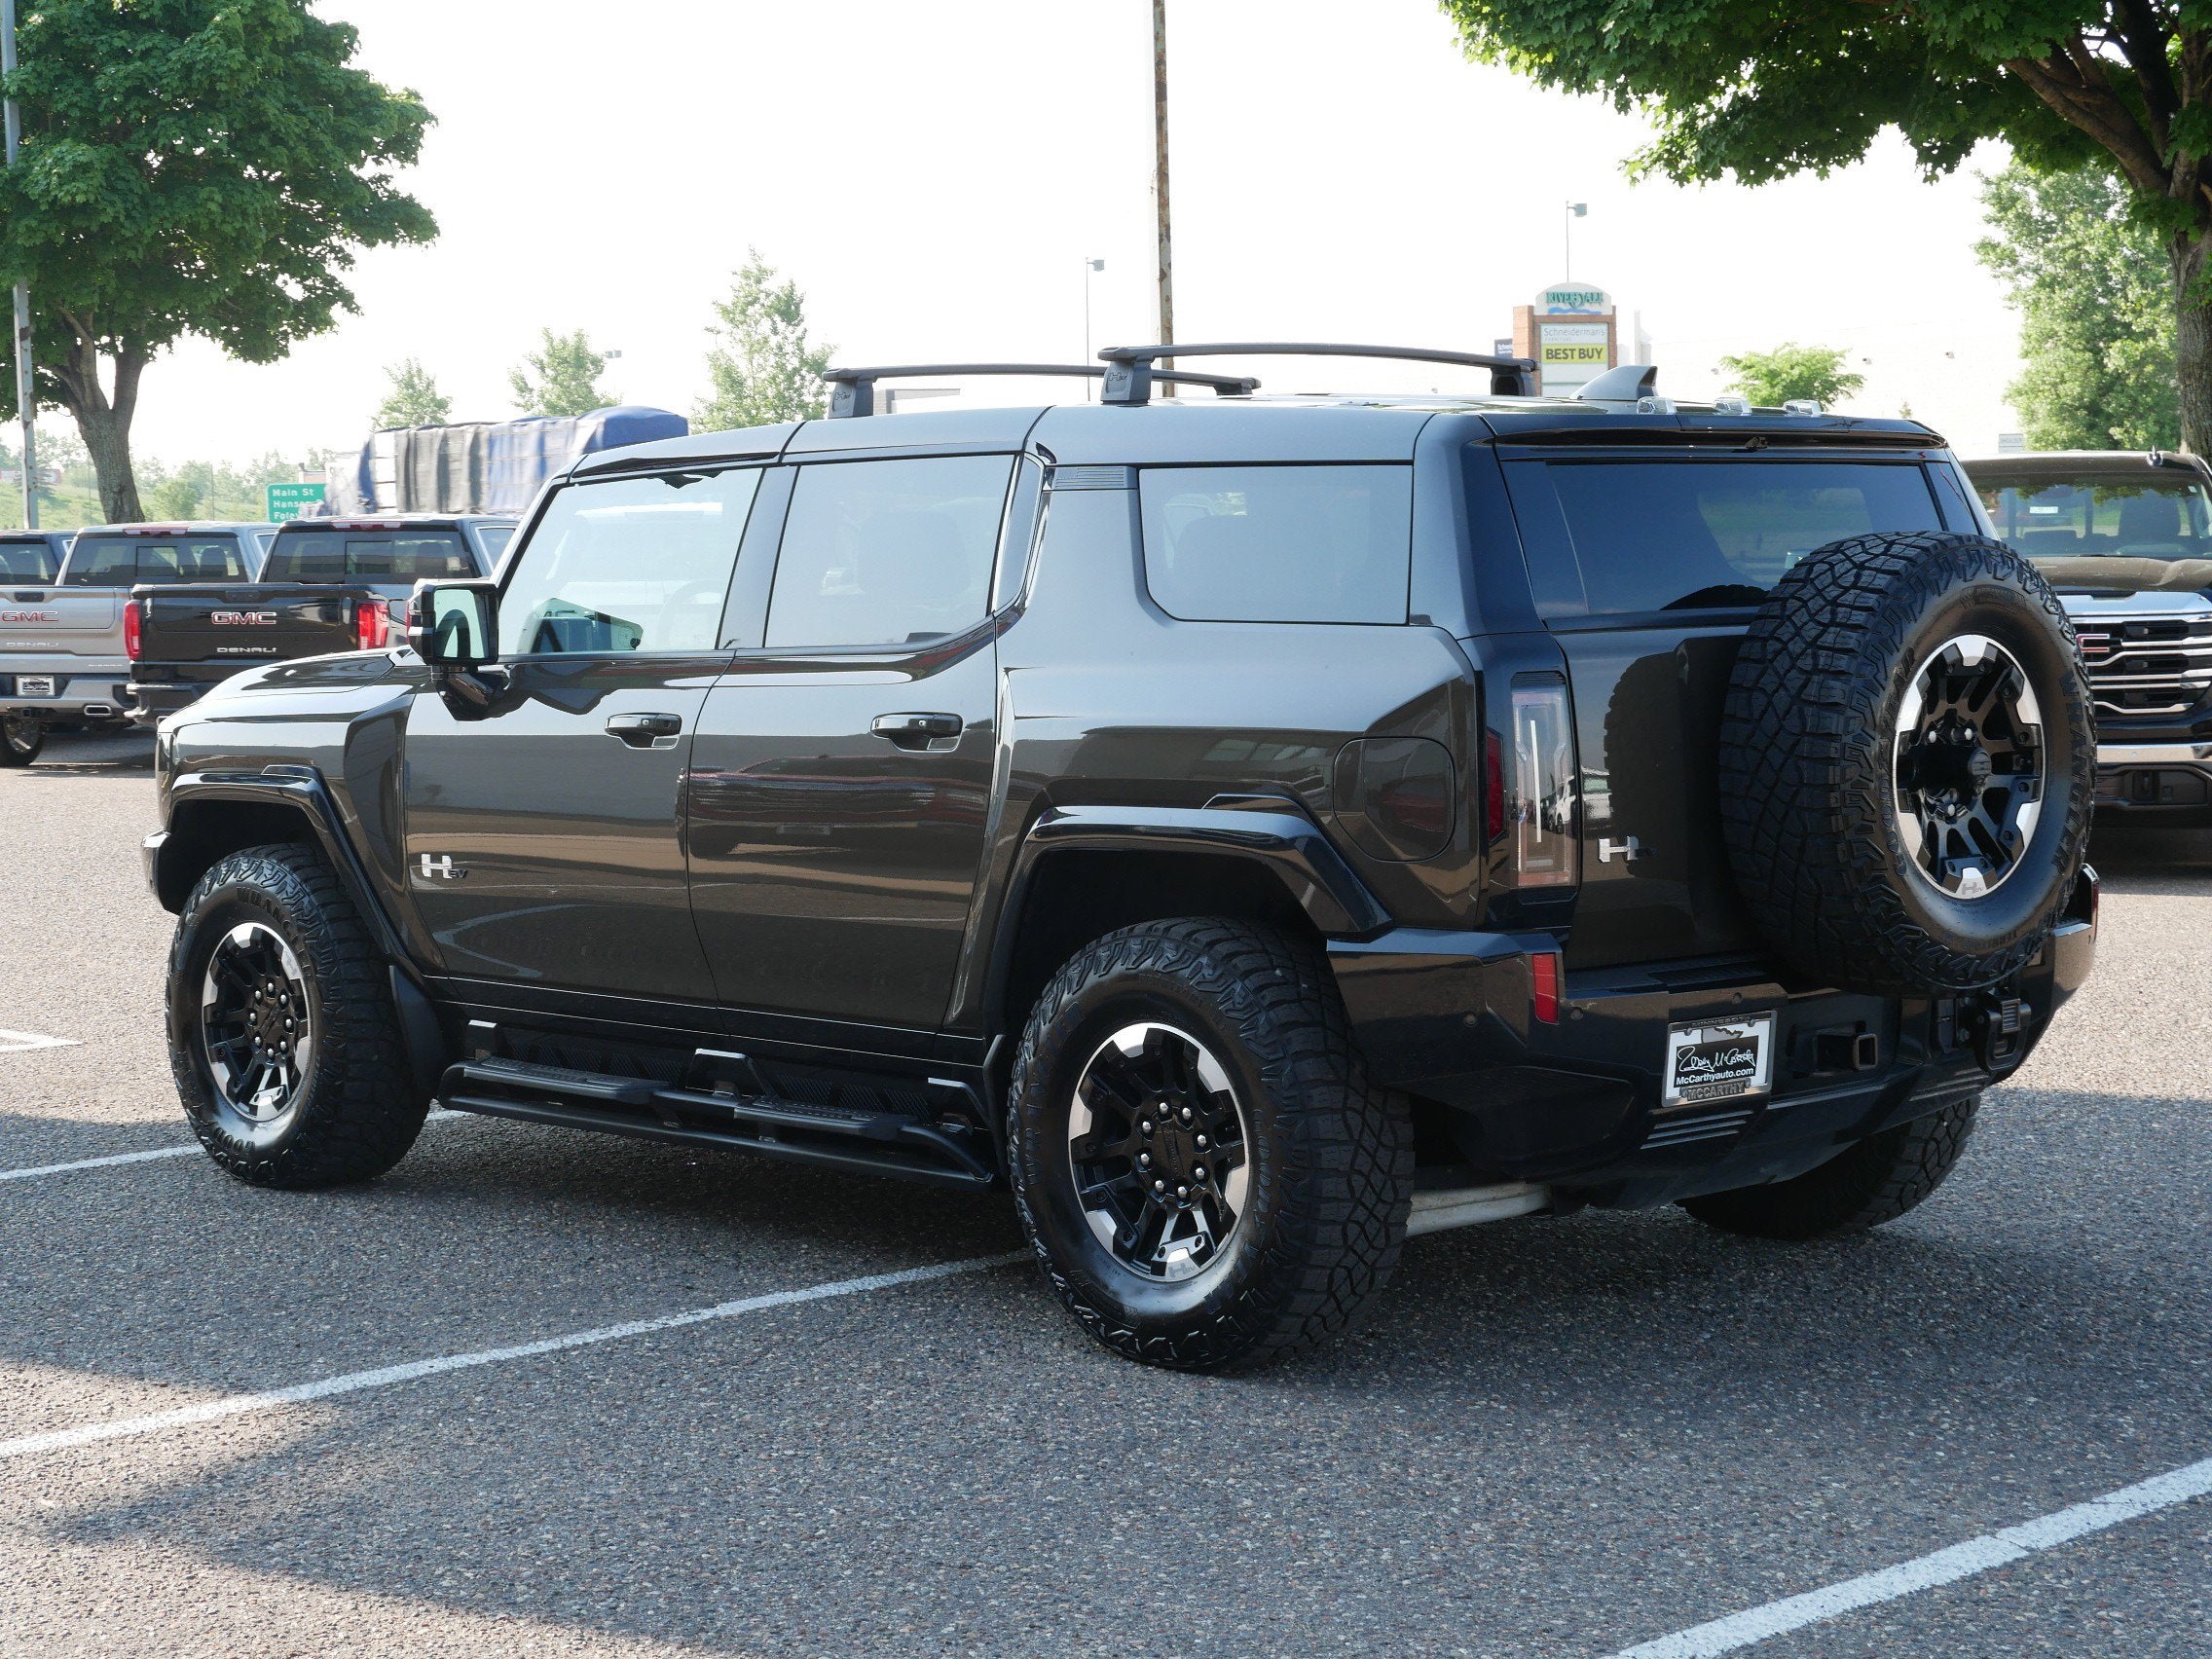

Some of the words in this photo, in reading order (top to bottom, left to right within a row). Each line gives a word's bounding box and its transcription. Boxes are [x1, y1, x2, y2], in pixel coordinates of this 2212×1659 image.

[1545, 348, 1576, 360] BEST
[1578, 348, 1604, 360] BUY
[272, 489, 298, 498] Main
[302, 488, 314, 497] St
[1, 611, 59, 623] GMC
[210, 611, 277, 624] GMC
[1676, 1068, 1754, 1086] McCarthyauto.com
[1686, 1081, 1746, 1100] MCCARTHY
